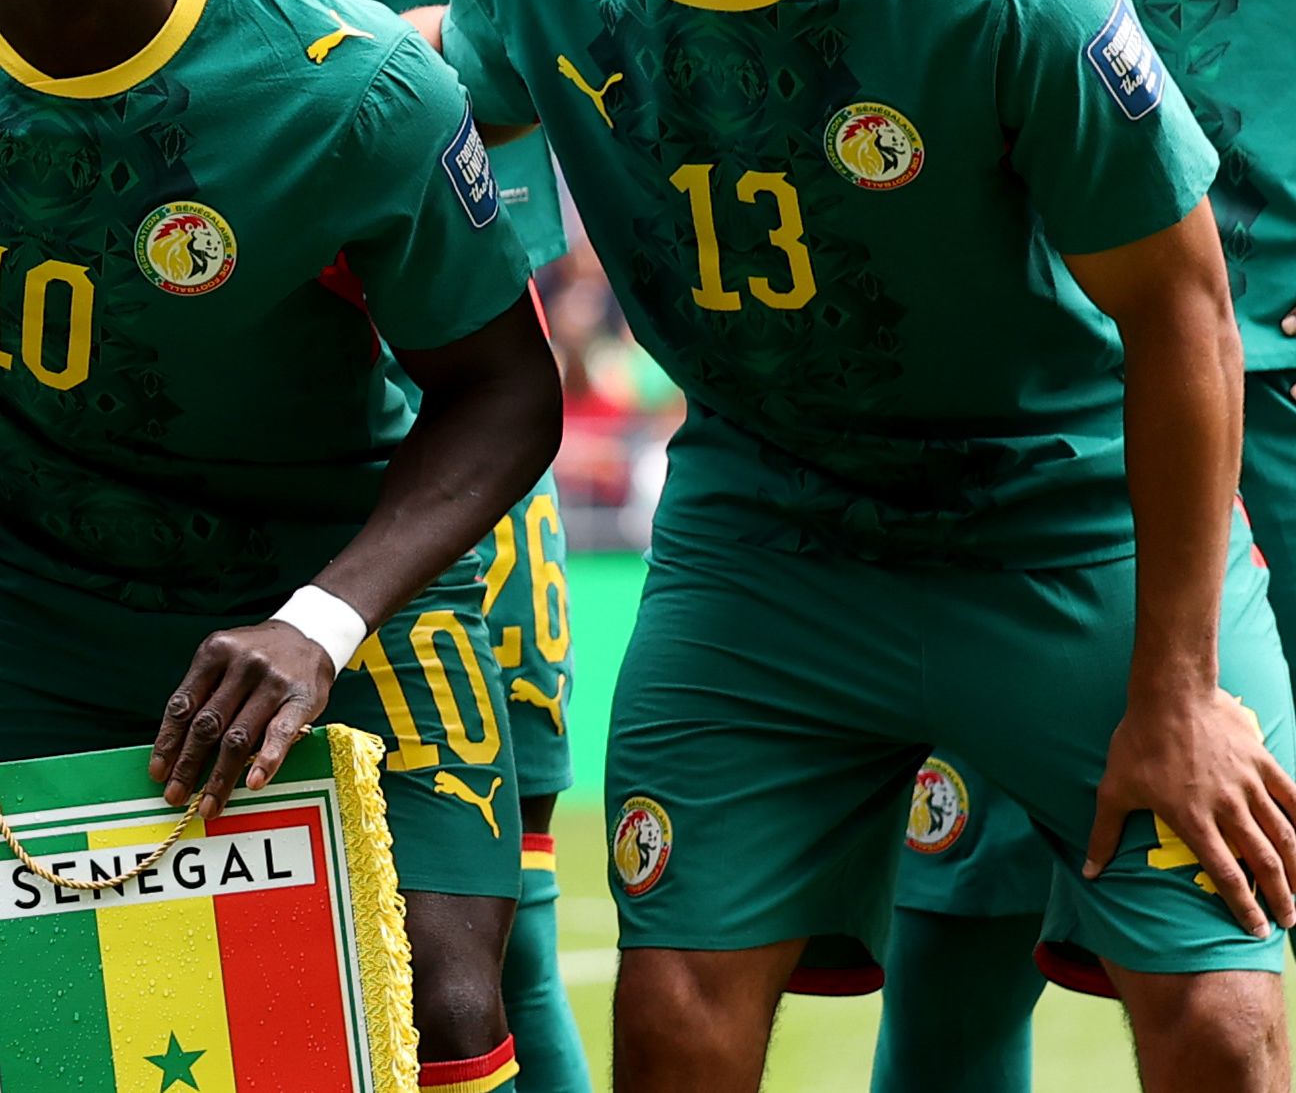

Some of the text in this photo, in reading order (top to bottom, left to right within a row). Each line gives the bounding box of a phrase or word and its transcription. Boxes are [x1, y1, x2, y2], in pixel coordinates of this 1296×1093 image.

[670, 164, 816, 311] 13
[482, 494, 570, 668] 26
[345, 609, 502, 772] 10
[11, 837, 293, 910] SENEGAL
